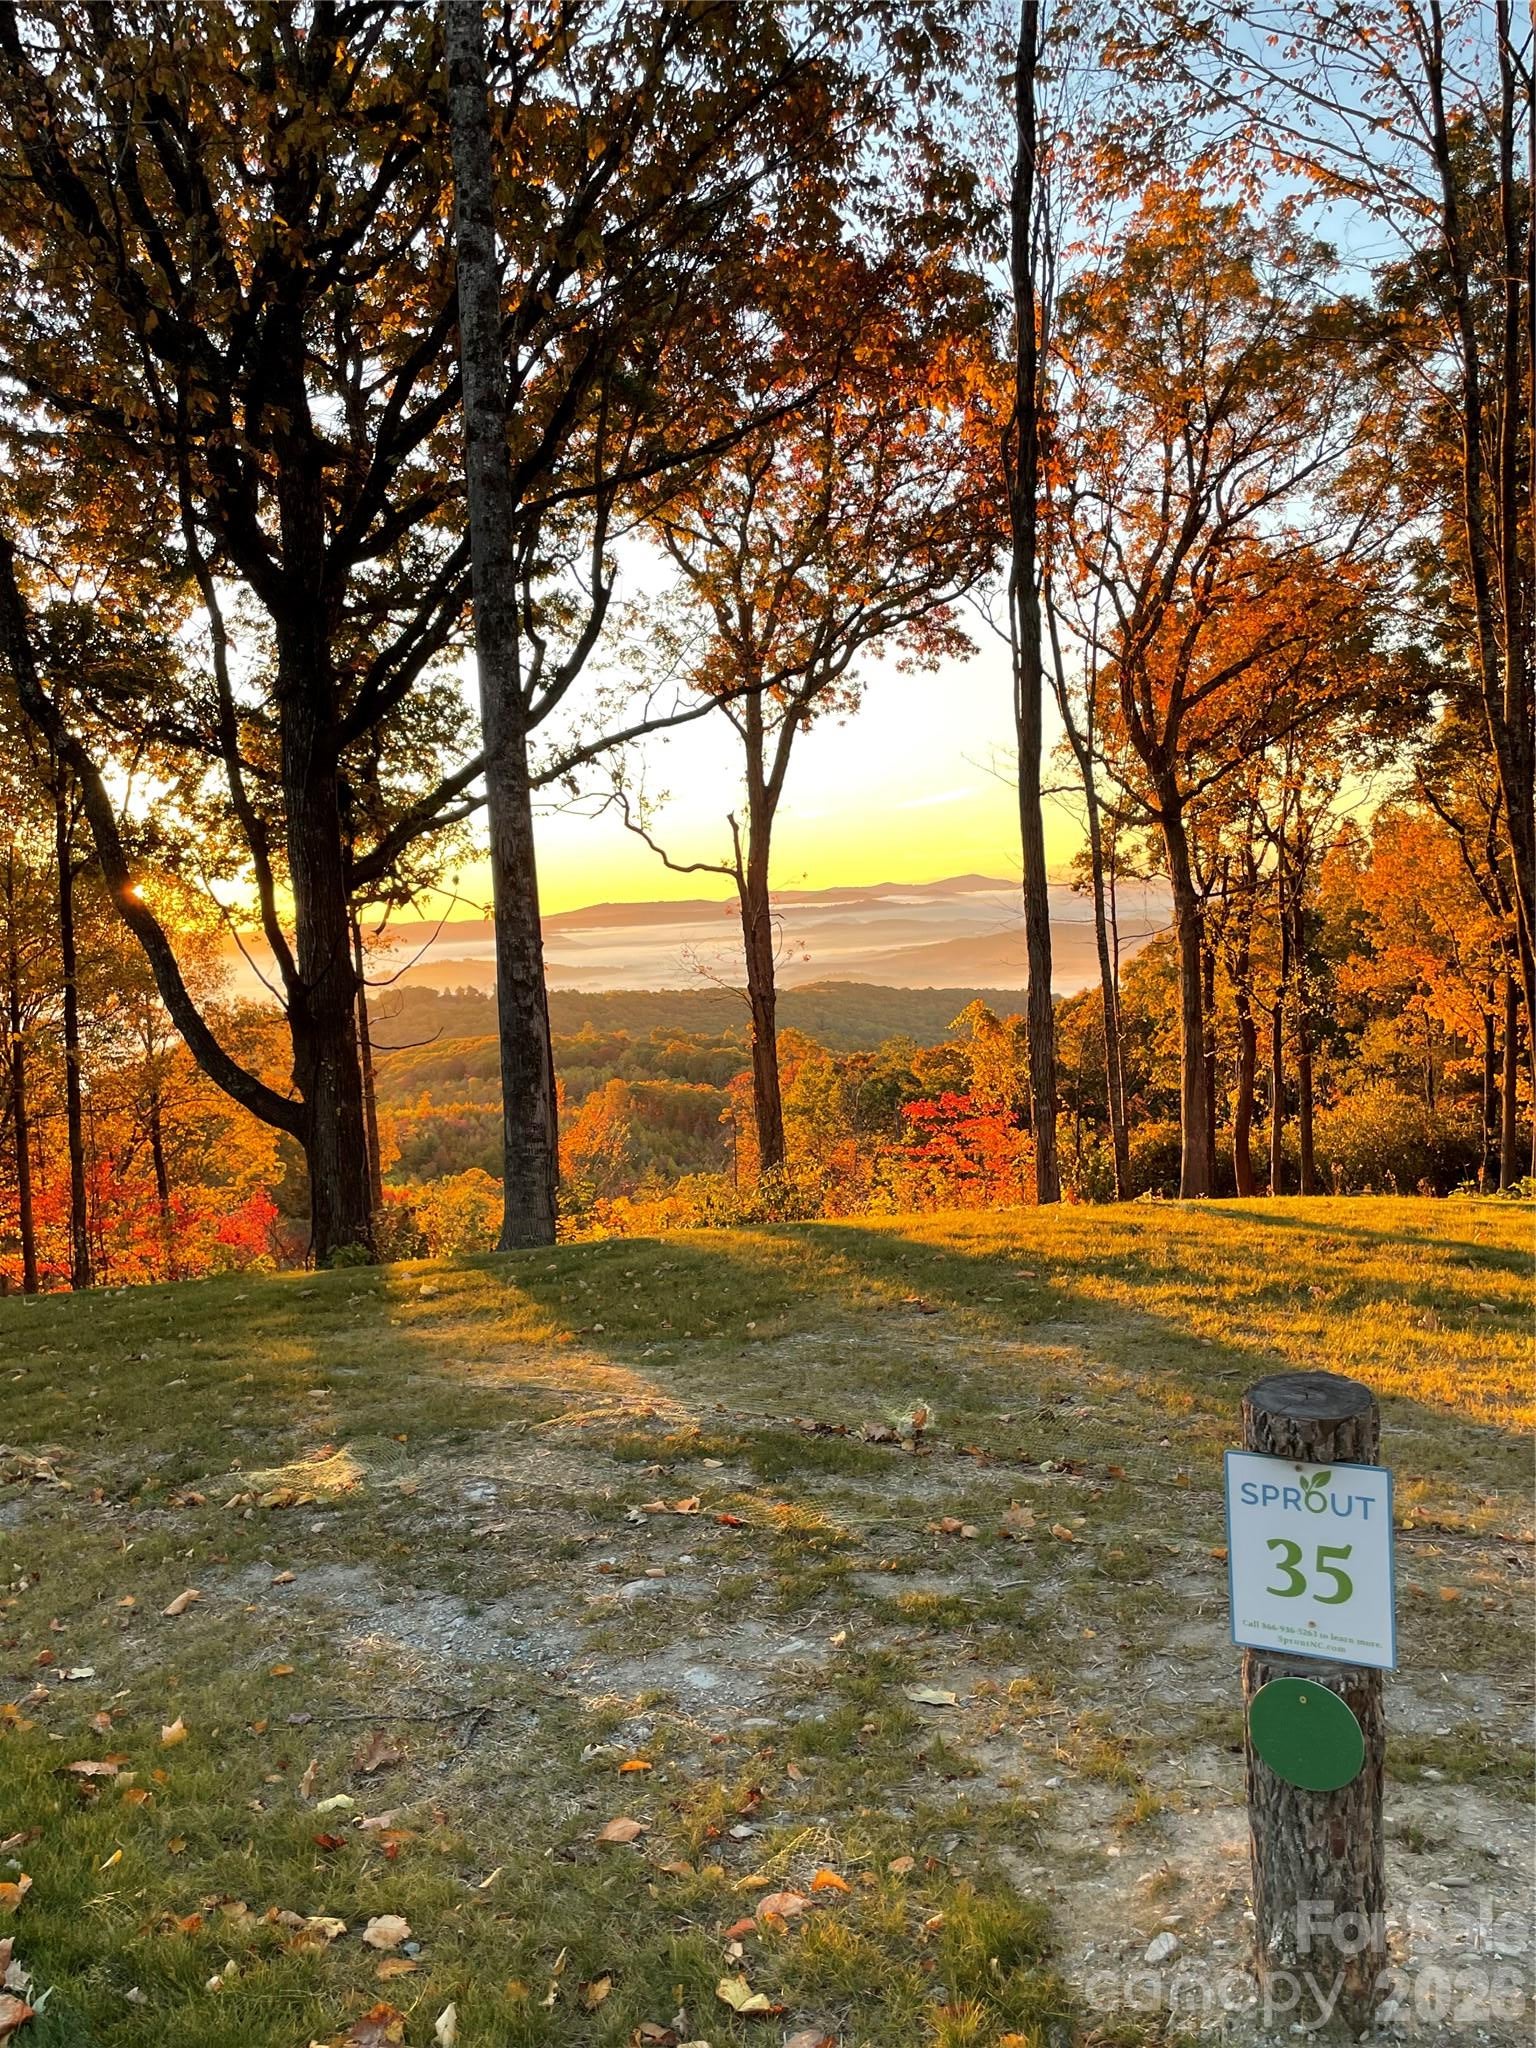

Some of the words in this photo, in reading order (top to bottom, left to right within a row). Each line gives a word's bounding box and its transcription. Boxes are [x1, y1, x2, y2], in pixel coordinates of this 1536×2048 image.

[1241, 1481, 1376, 1521] SPROUT
[1266, 1538, 1354, 1605] 35
[1242, 1619, 1260, 1629] Call
[1330, 1632, 1355, 1645] learn
